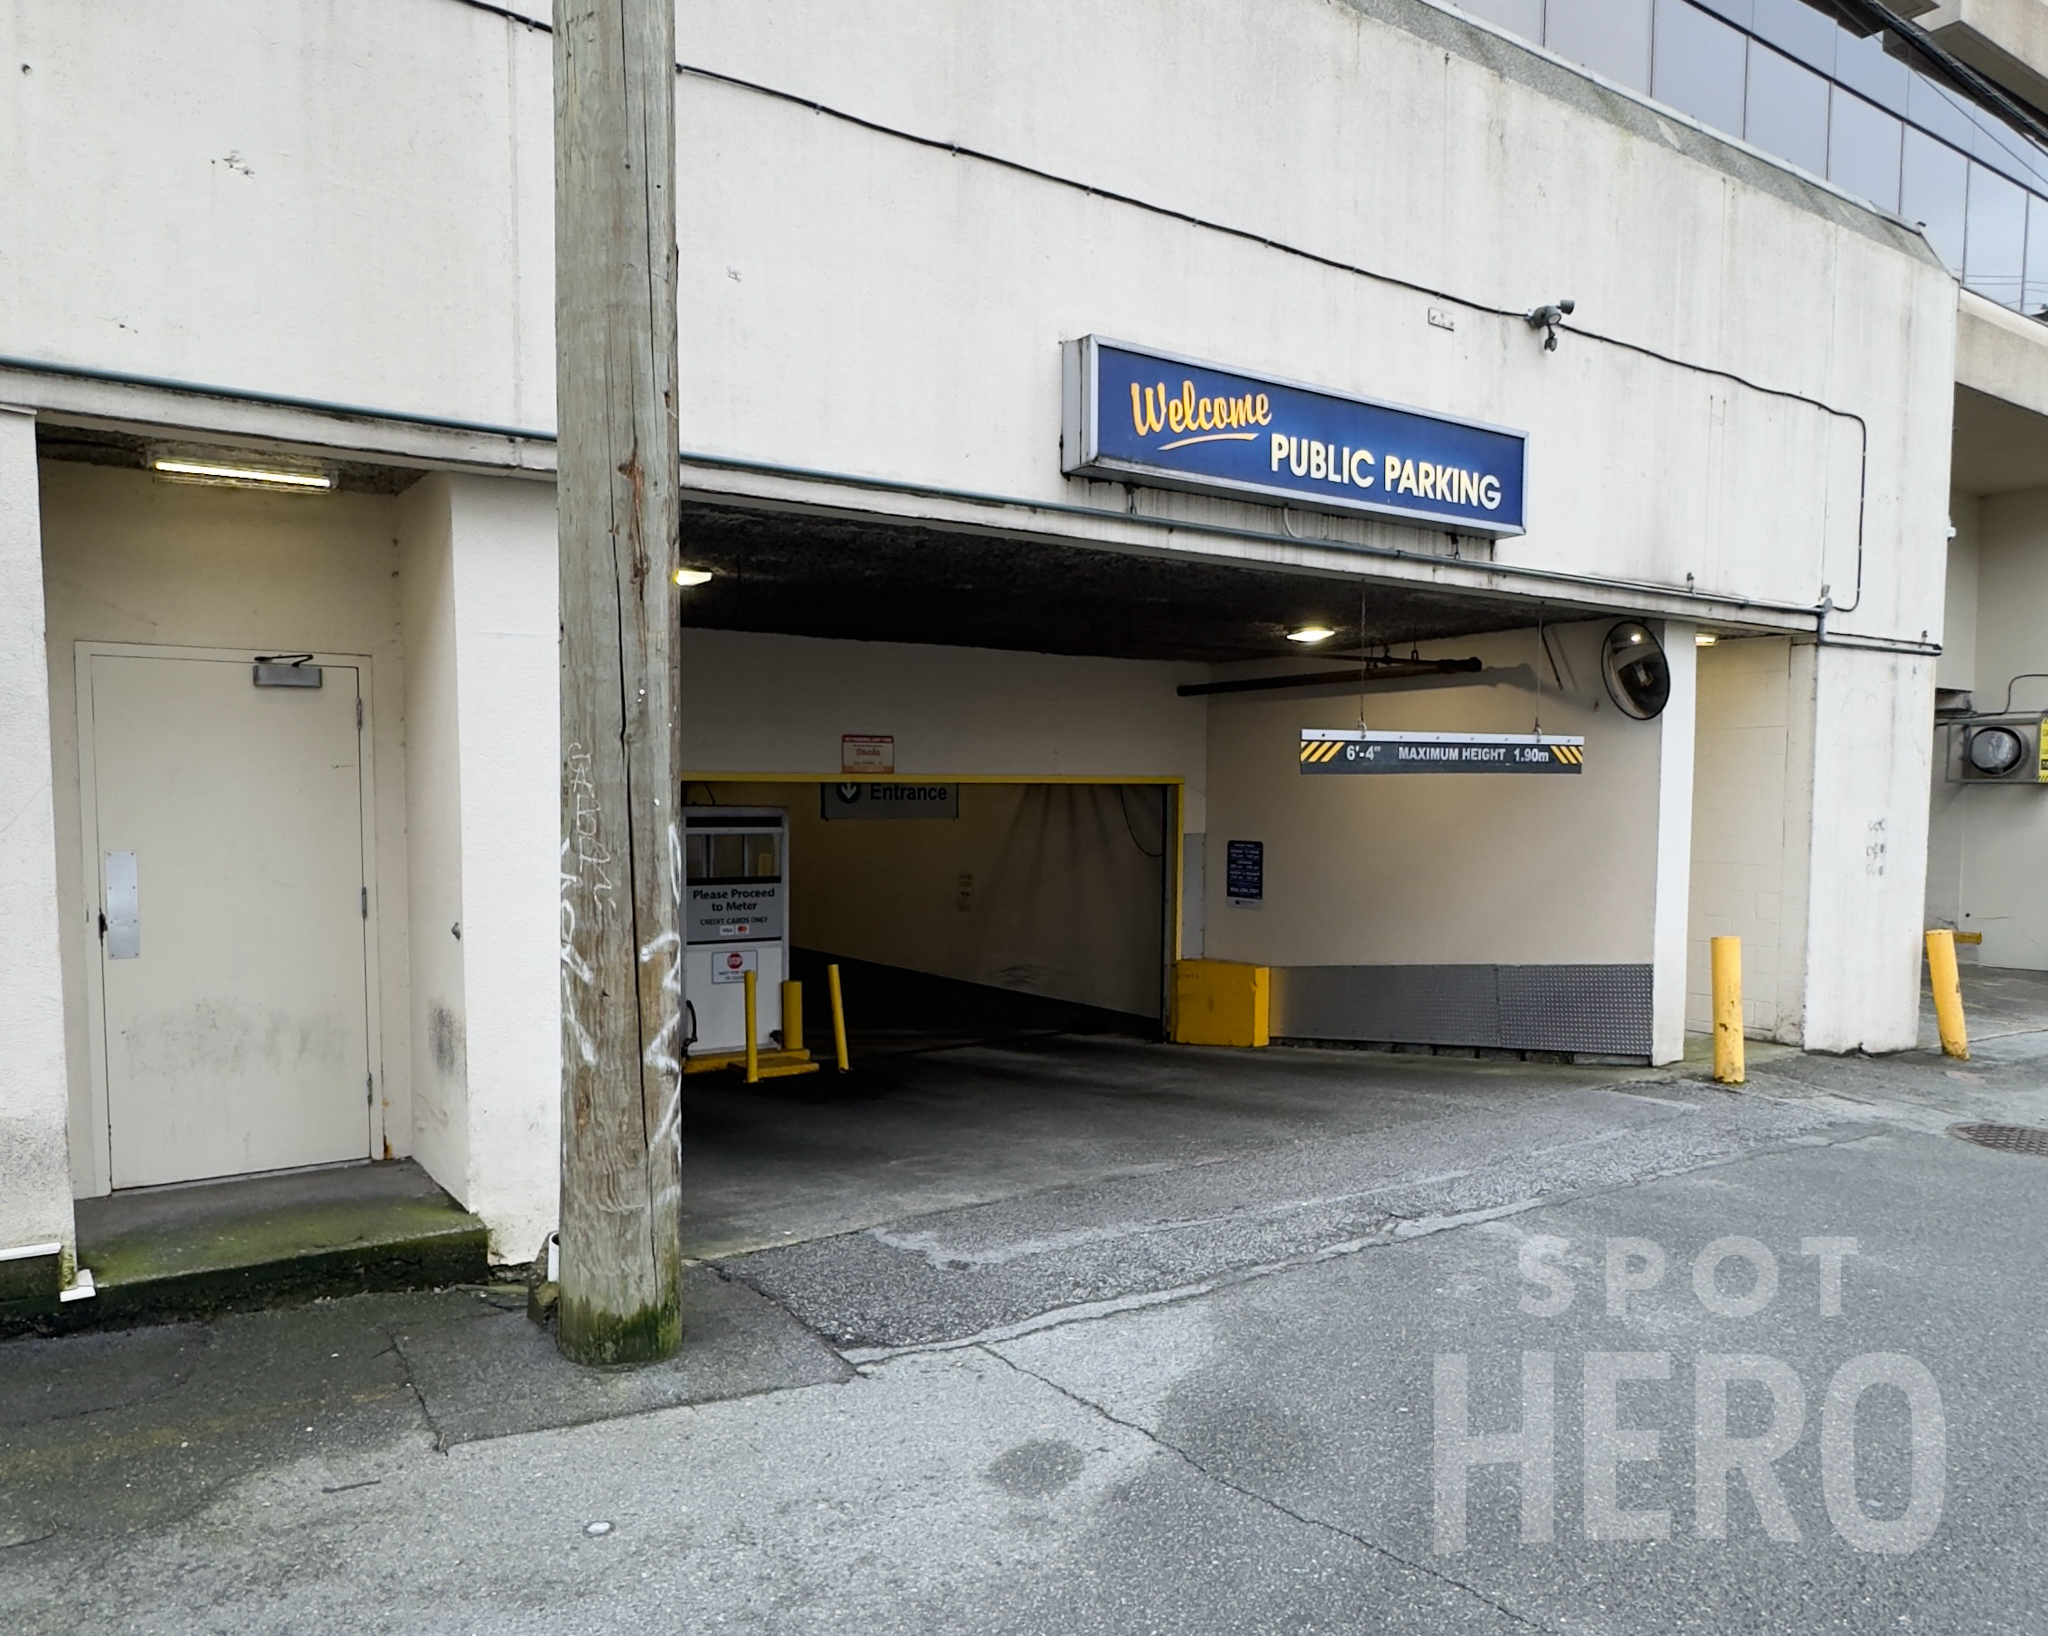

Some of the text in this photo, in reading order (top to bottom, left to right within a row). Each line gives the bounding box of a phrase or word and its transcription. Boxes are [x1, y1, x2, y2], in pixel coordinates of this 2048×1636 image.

[1131, 379, 1273, 437] Welcome
[1270, 432, 1502, 511] PUBLIC PARKING
[1397, 745, 1460, 761] MAXIMUM
[1461, 746, 1507, 762] HEIGHT
[1512, 748, 1550, 763] 1.90m
[870, 783, 947, 800] Entrance
[693, 887, 775, 899] Please Proceed
[711, 902, 757, 912] to Meter
[700, 917, 725, 925] CREDIT
[726, 916, 750, 925] CARDS
